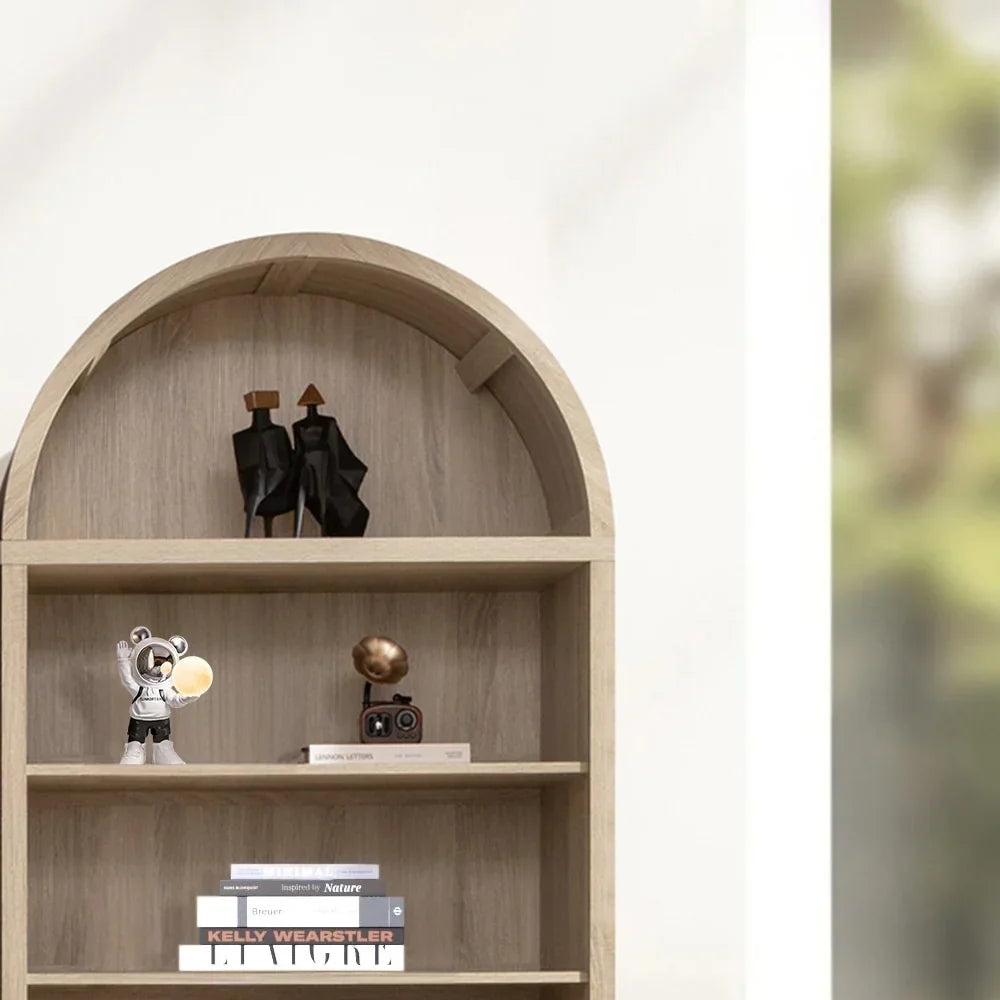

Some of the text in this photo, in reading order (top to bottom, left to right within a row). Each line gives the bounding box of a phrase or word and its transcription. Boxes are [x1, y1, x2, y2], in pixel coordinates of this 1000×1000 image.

[281, 883, 362, 893] Inspired by Nature
[252, 907, 283, 916] Breuer
[207, 931, 394, 942] KELLY WEARSTLER
